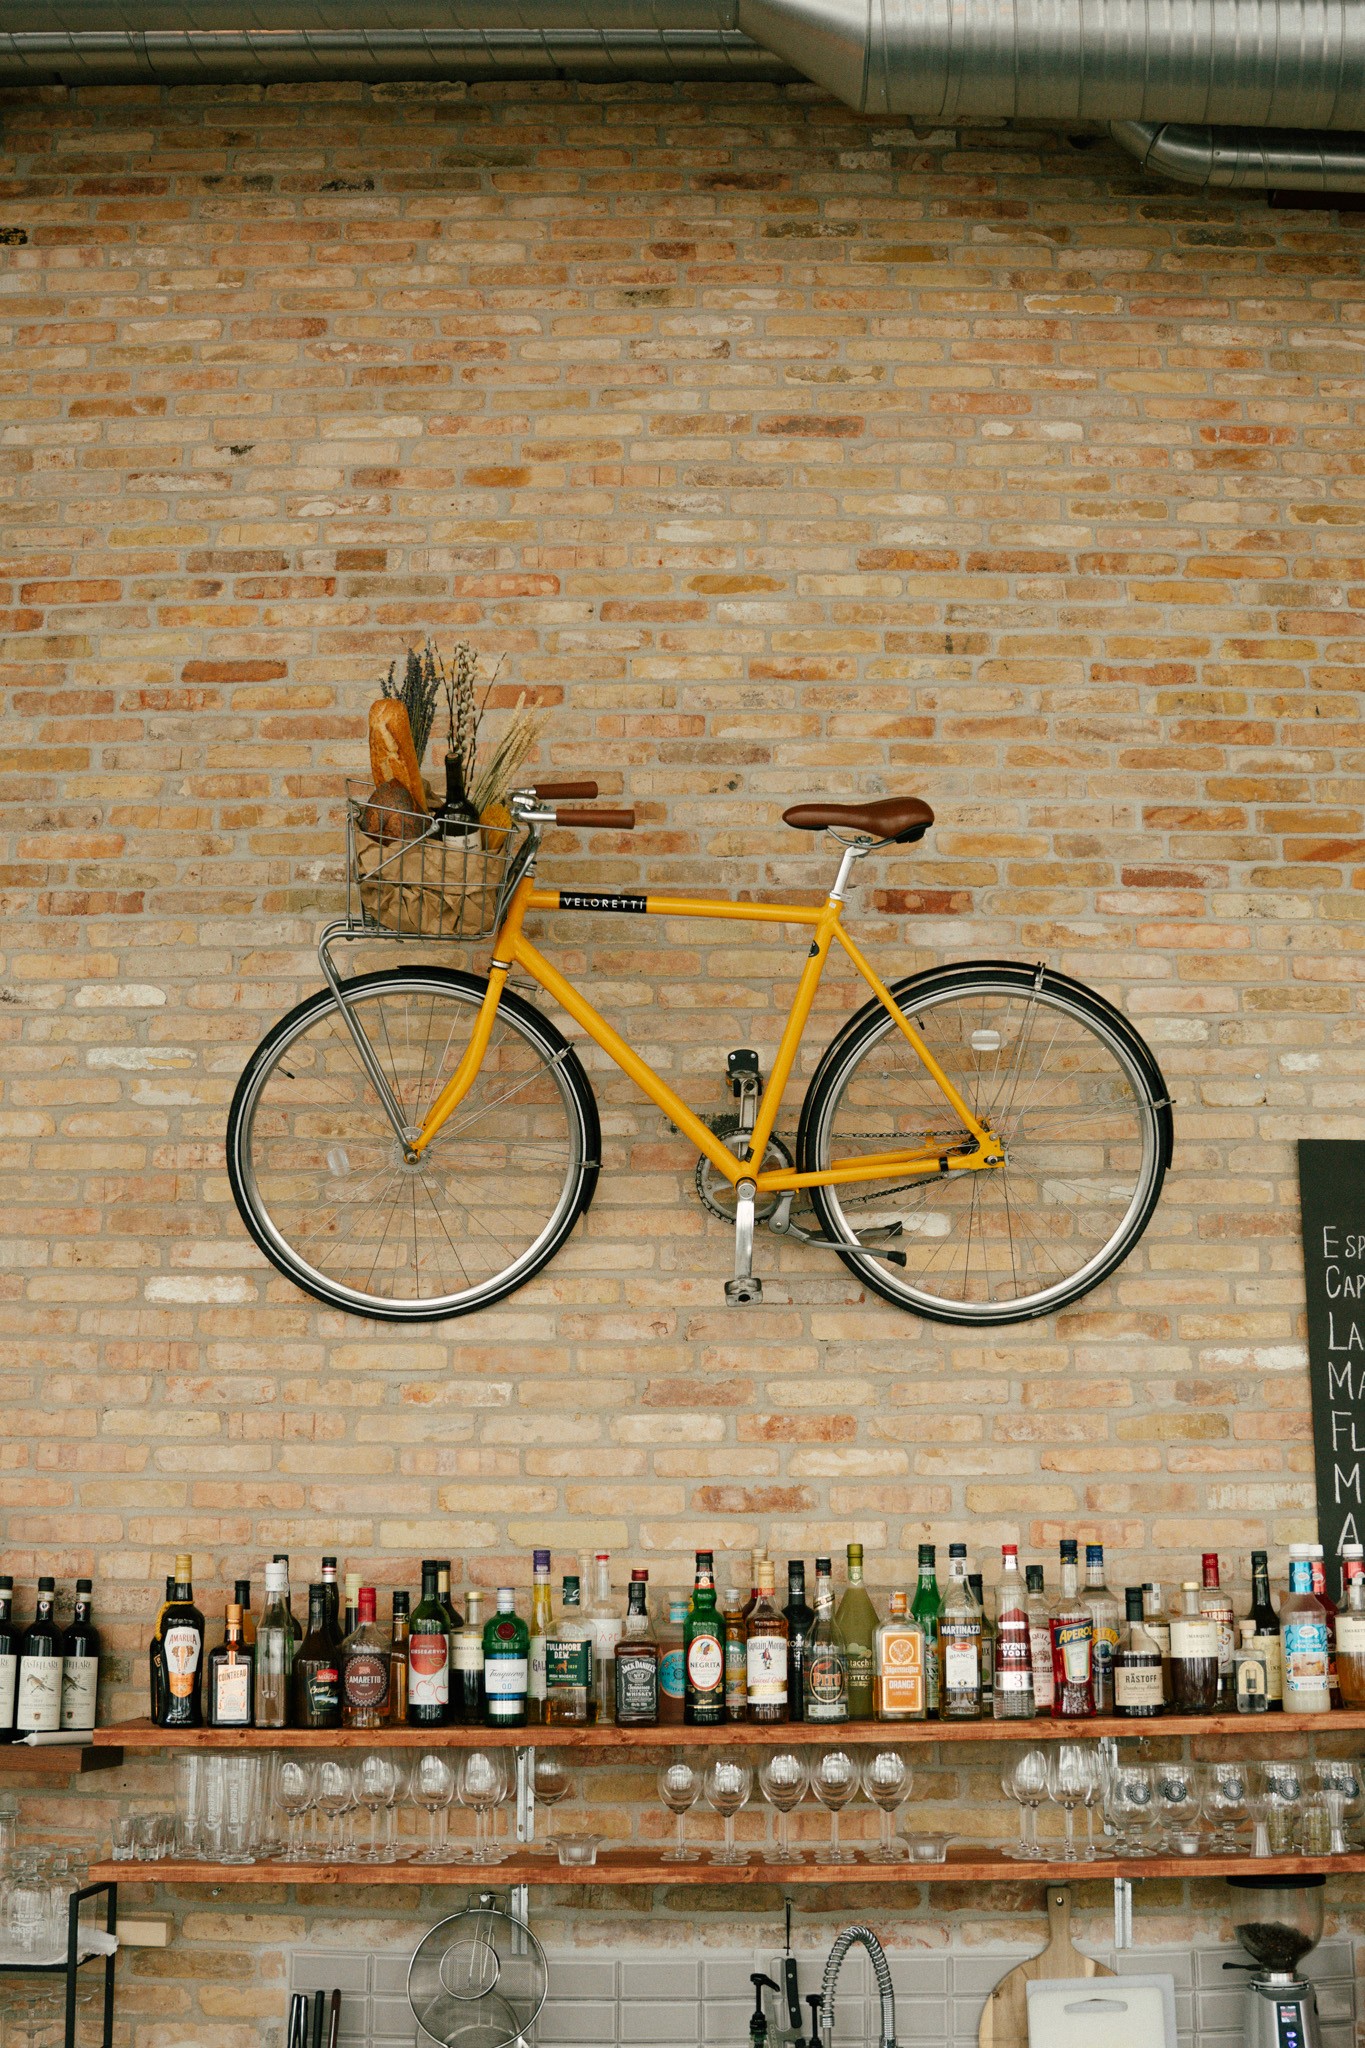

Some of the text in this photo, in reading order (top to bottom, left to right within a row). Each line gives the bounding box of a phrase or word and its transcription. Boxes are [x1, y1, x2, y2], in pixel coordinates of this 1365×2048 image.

[564, 897, 643, 909] VELORETTI
[1328, 1311, 1364, 1351] LA
[1335, 1463, 1361, 1503] M
[942, 1624, 980, 1635] MARTINAZZI
[1059, 1624, 1092, 1645] APEROL
[168, 1633, 197, 1646] AMARULA
[547, 1643, 582, 1651] TULLAMORE
[748, 1641, 767, 1652] Captain
[489, 1668, 525, 1680] Tanqueray
[621, 1662, 635, 1674] JACK
[219, 1669, 247, 1682] COINTREAU
[349, 1676, 382, 1684] AMARETTO
[889, 1680, 915, 1689] ORANGE
